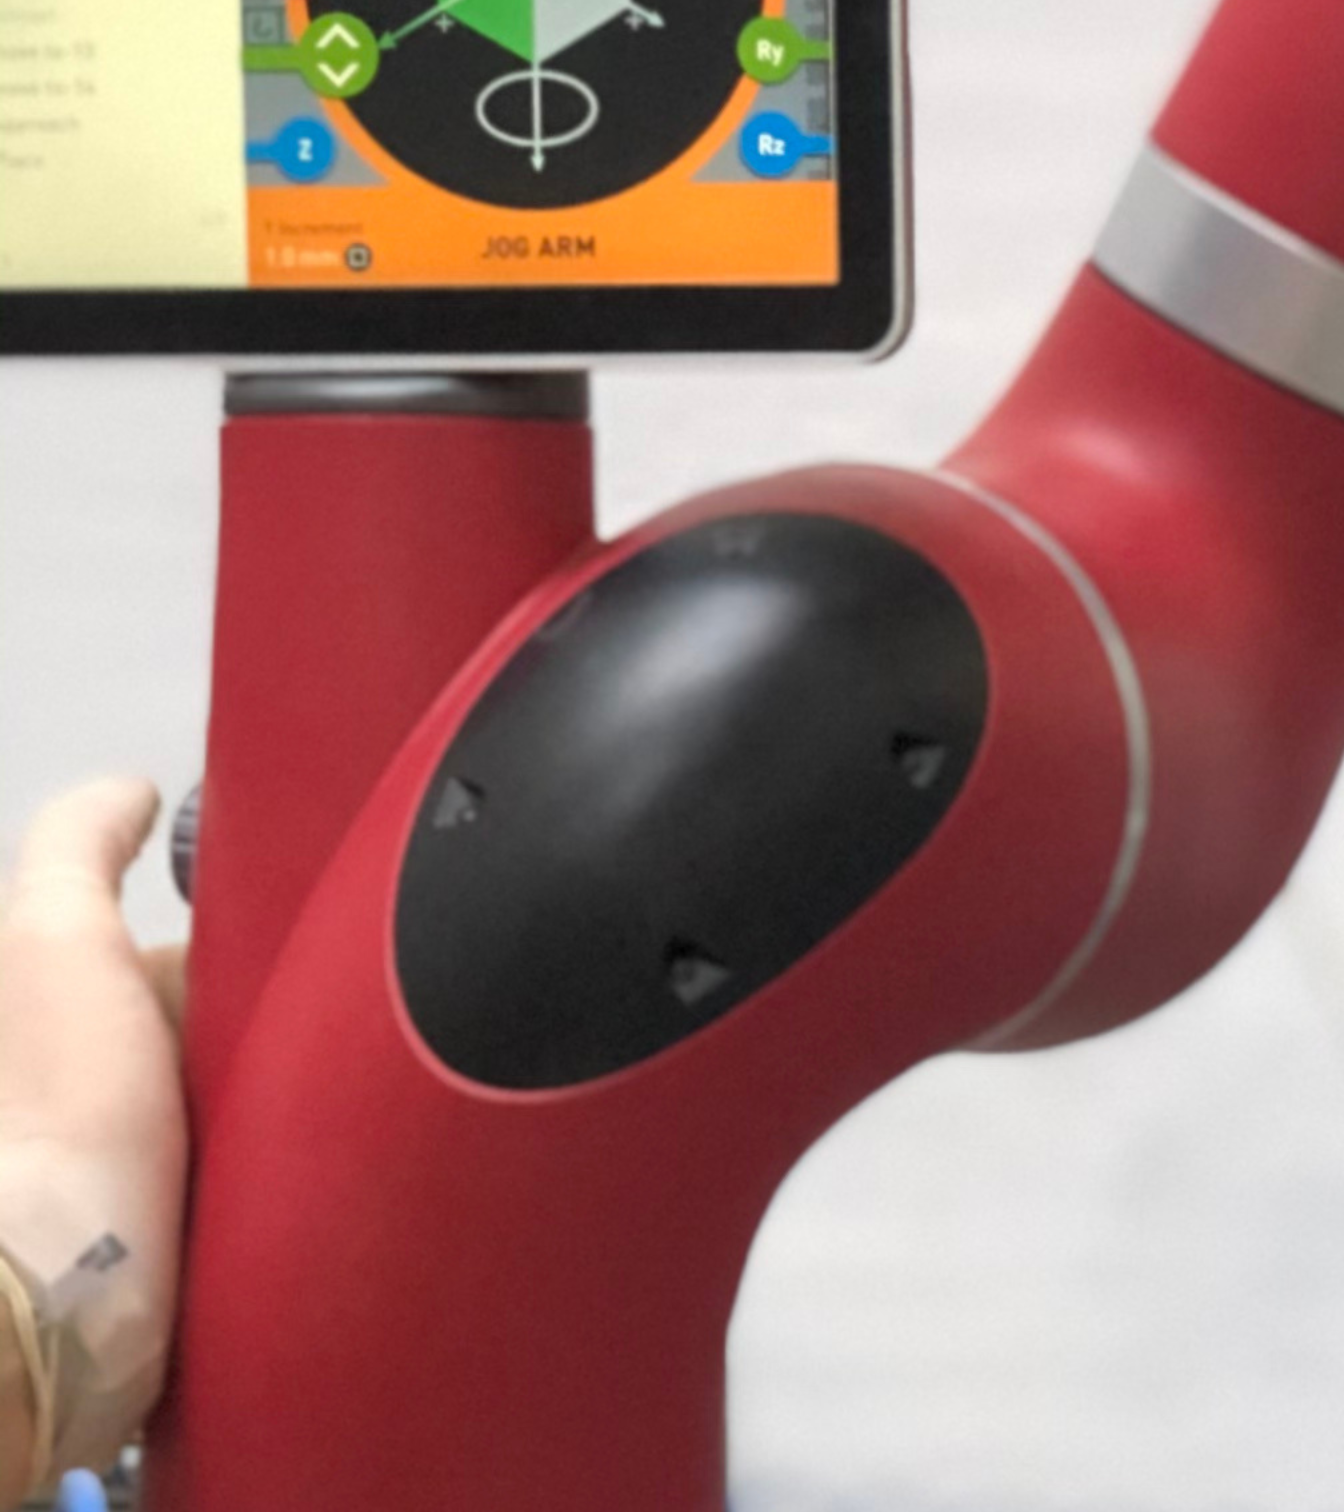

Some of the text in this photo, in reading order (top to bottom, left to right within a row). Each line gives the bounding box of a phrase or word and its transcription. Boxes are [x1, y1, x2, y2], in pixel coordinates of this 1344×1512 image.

[756, 39, 785, 66] Ry
[299, 137, 313, 161] Z
[758, 132, 786, 156] Rz
[481, 234, 596, 259] JOG ARM
